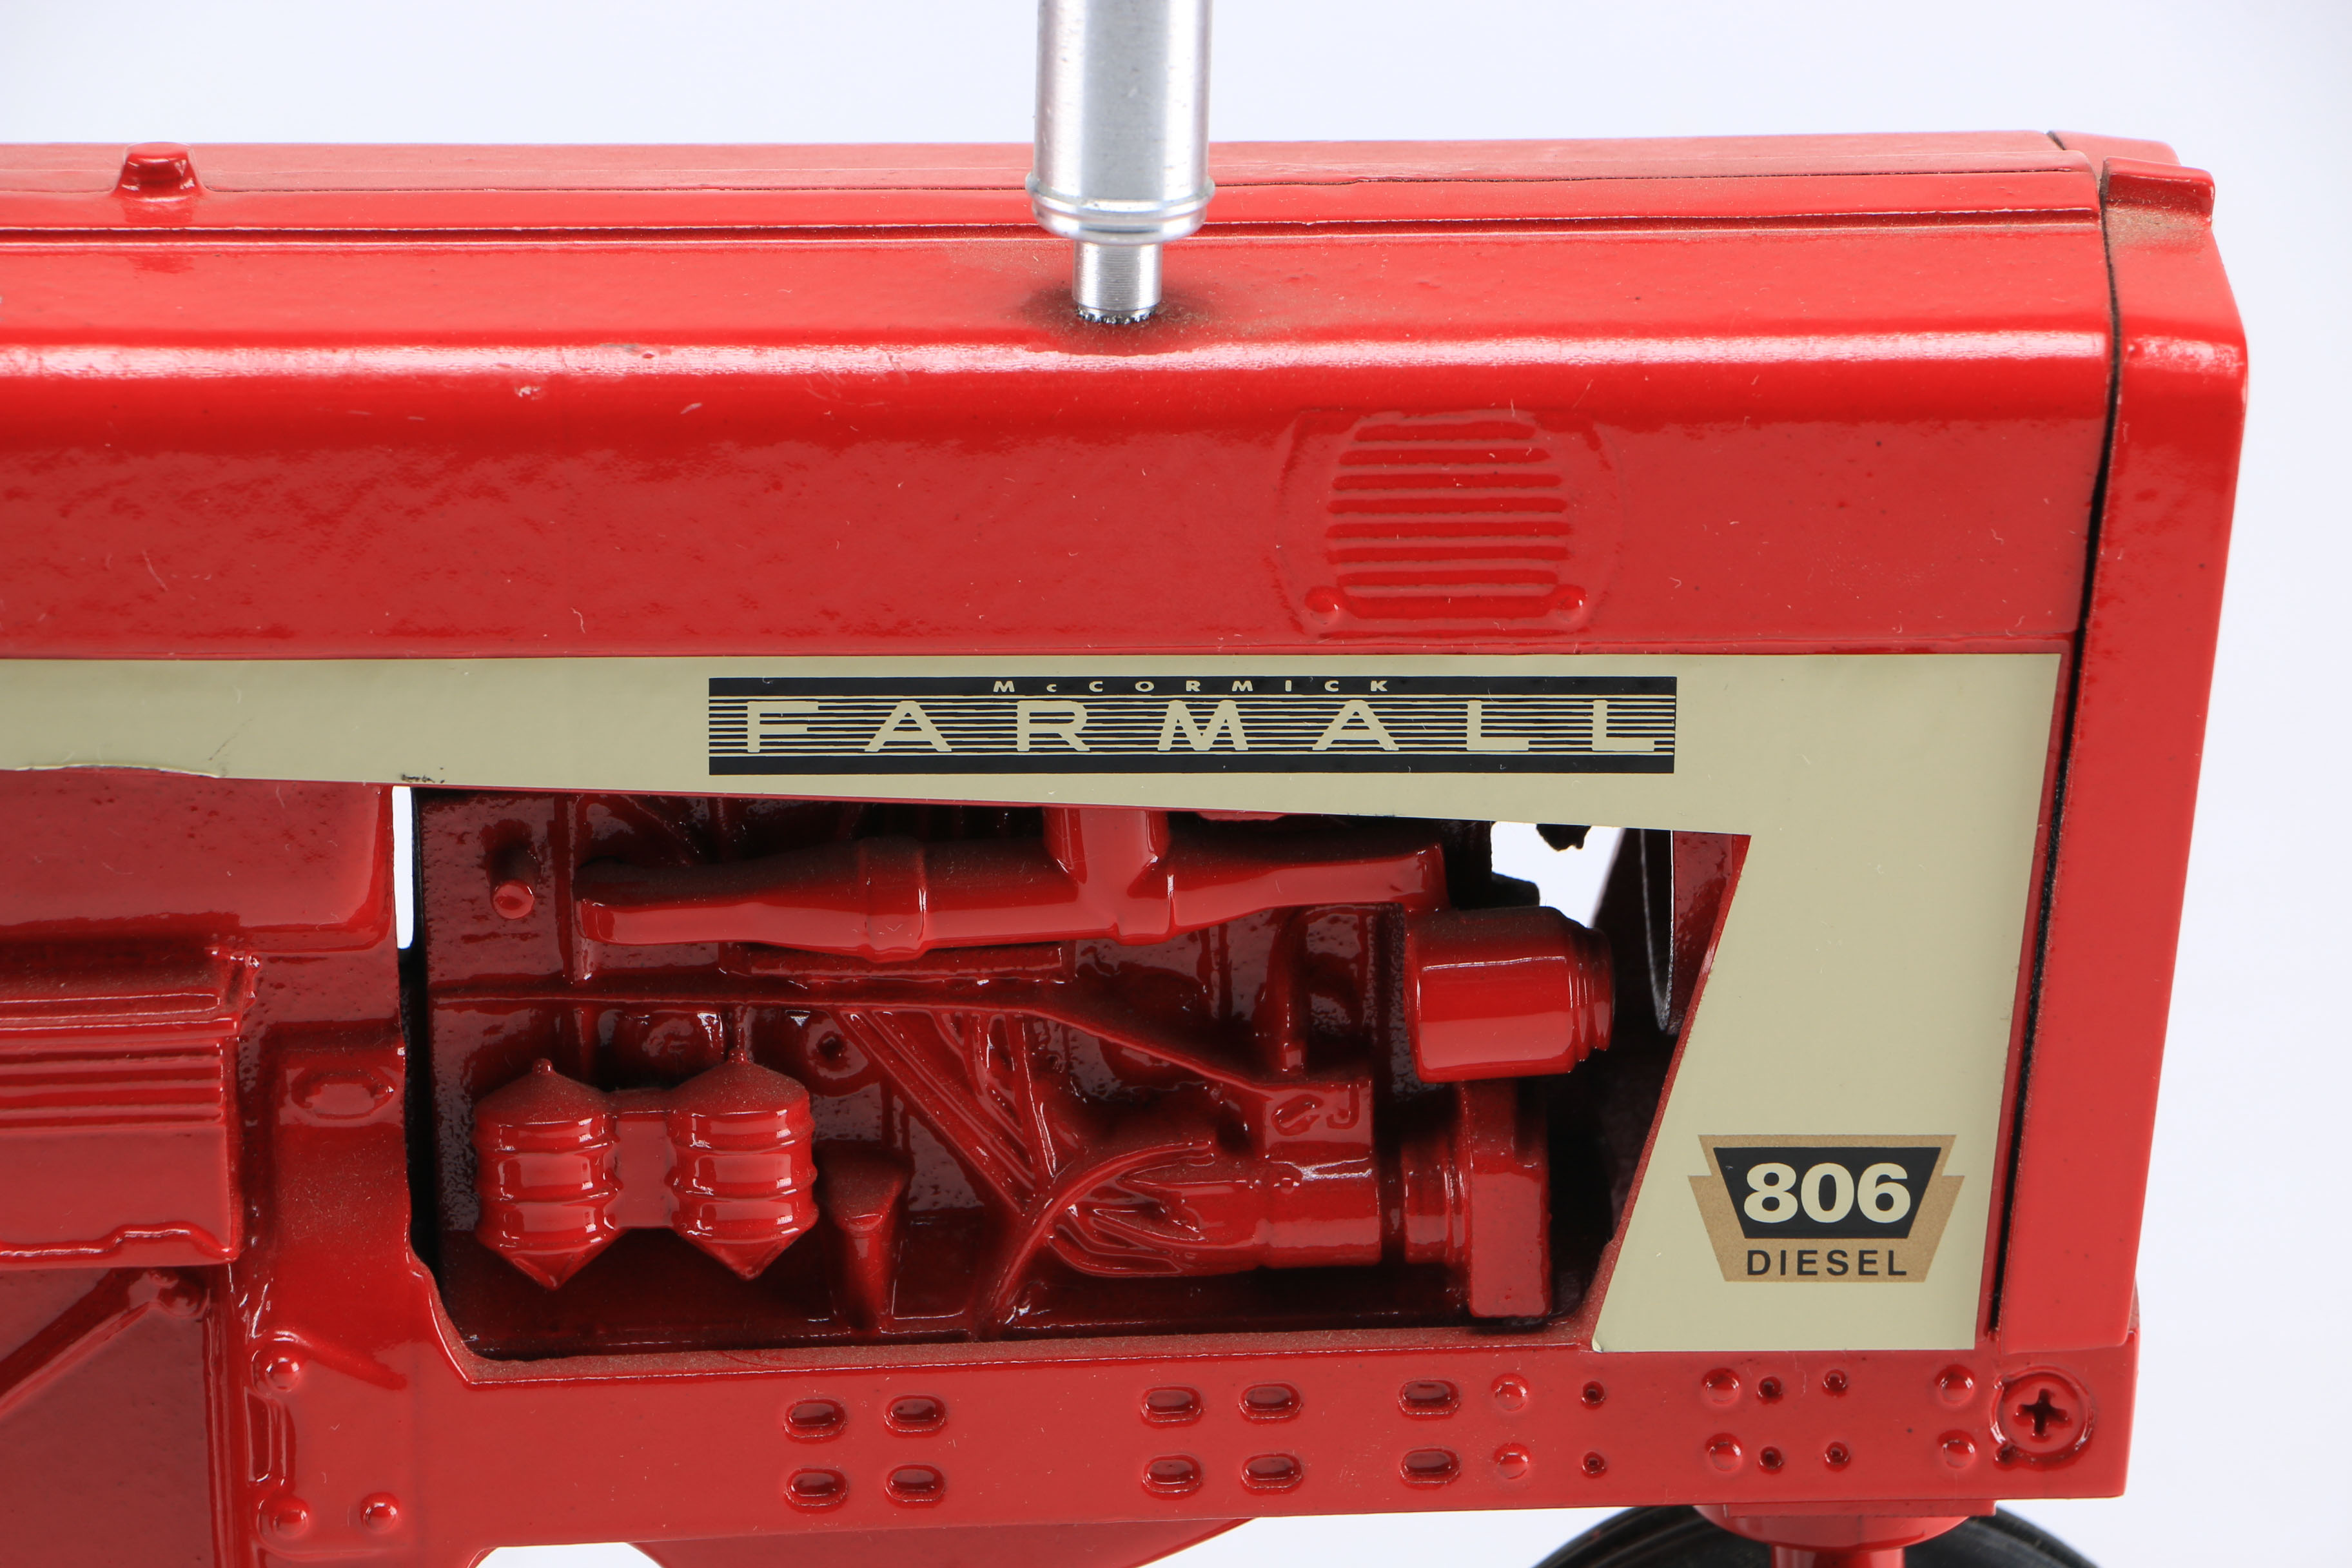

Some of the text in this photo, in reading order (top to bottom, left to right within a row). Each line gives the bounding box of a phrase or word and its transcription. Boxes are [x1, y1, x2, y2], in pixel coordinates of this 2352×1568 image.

[993, 680, 1388, 693] McCORMICK
[747, 700, 1655, 752] FARMALL
[1743, 1162, 1911, 1223] 806
[1747, 1250, 1907, 1276] DIESEL
